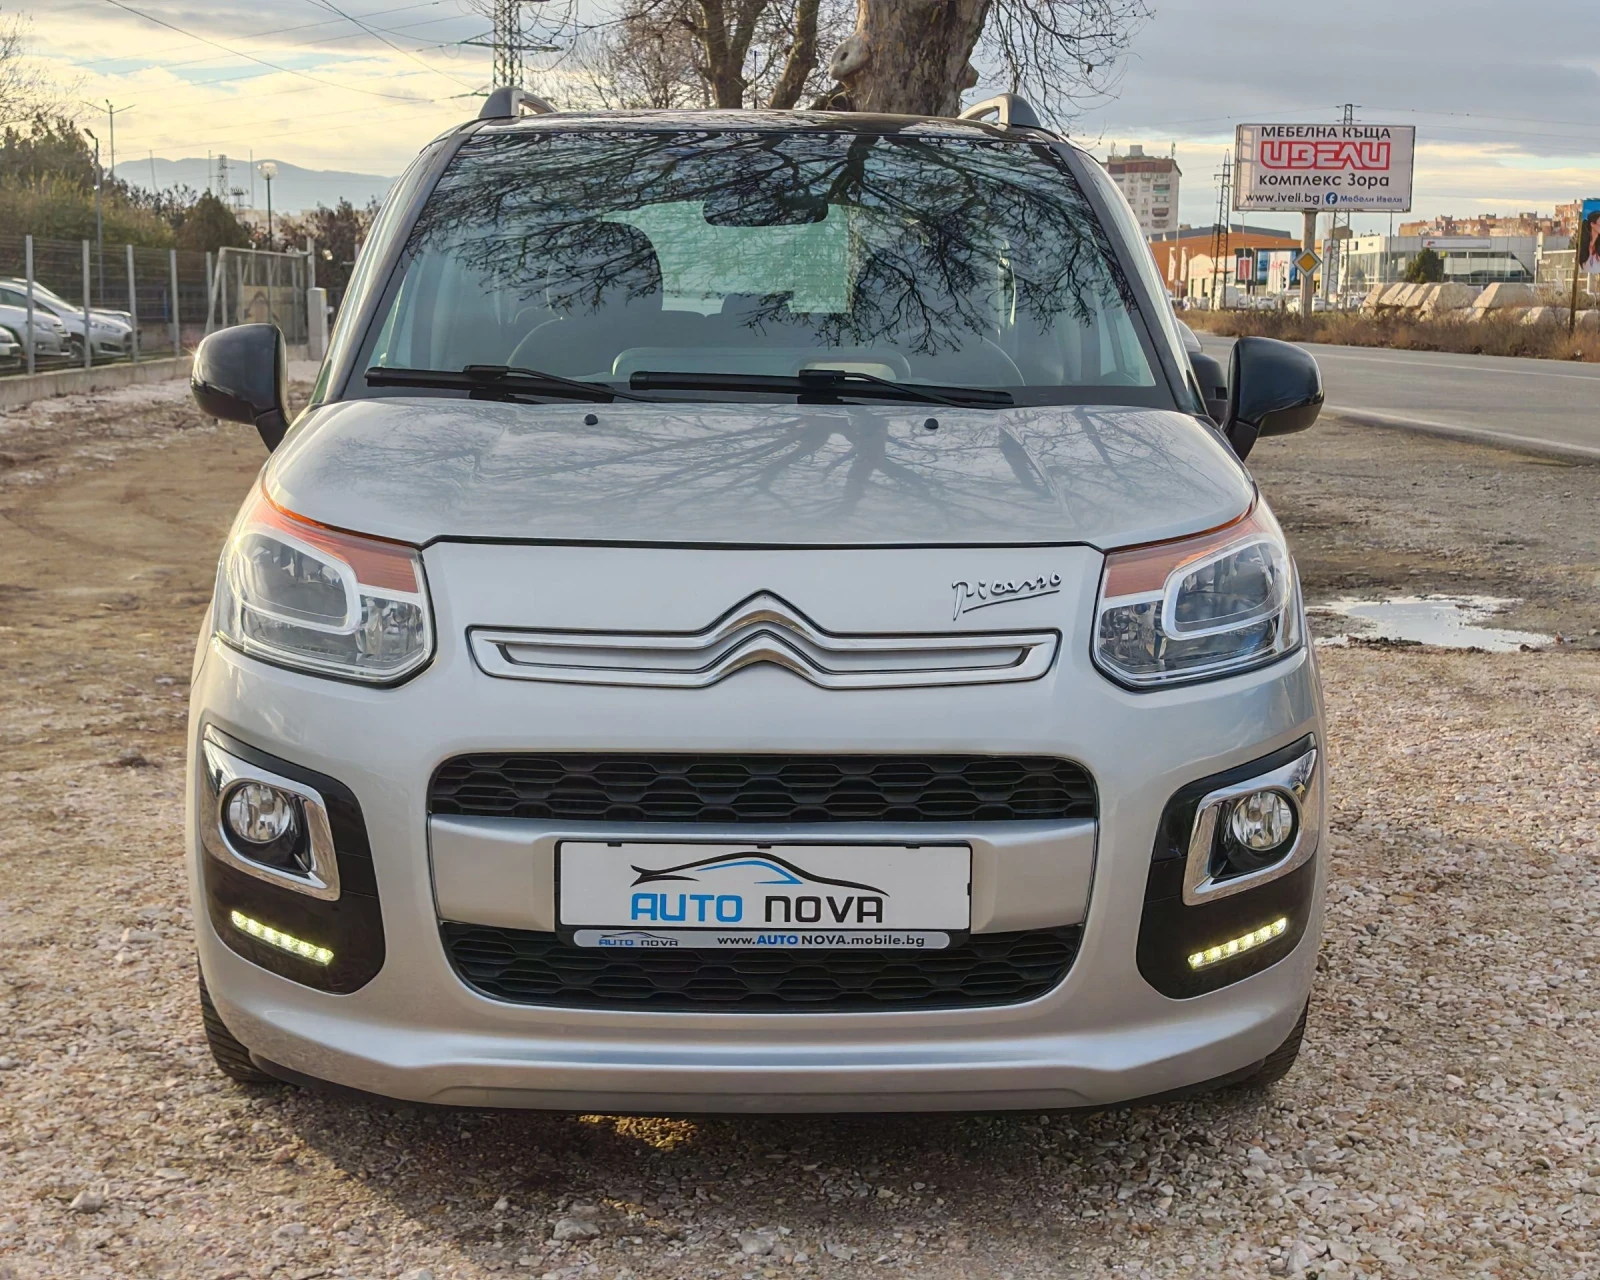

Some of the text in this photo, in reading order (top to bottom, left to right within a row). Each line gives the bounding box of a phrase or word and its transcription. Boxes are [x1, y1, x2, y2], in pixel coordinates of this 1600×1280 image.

[1261, 126, 1391, 140] МЕБЕЛНА КЪЩА
[1260, 141, 1390, 170] ИВЕЛИ
[1347, 173, 1389, 189] Зора
[1245, 192, 1320, 205] www.iveli.bg
[631, 892, 883, 923] AUTO NOVA
